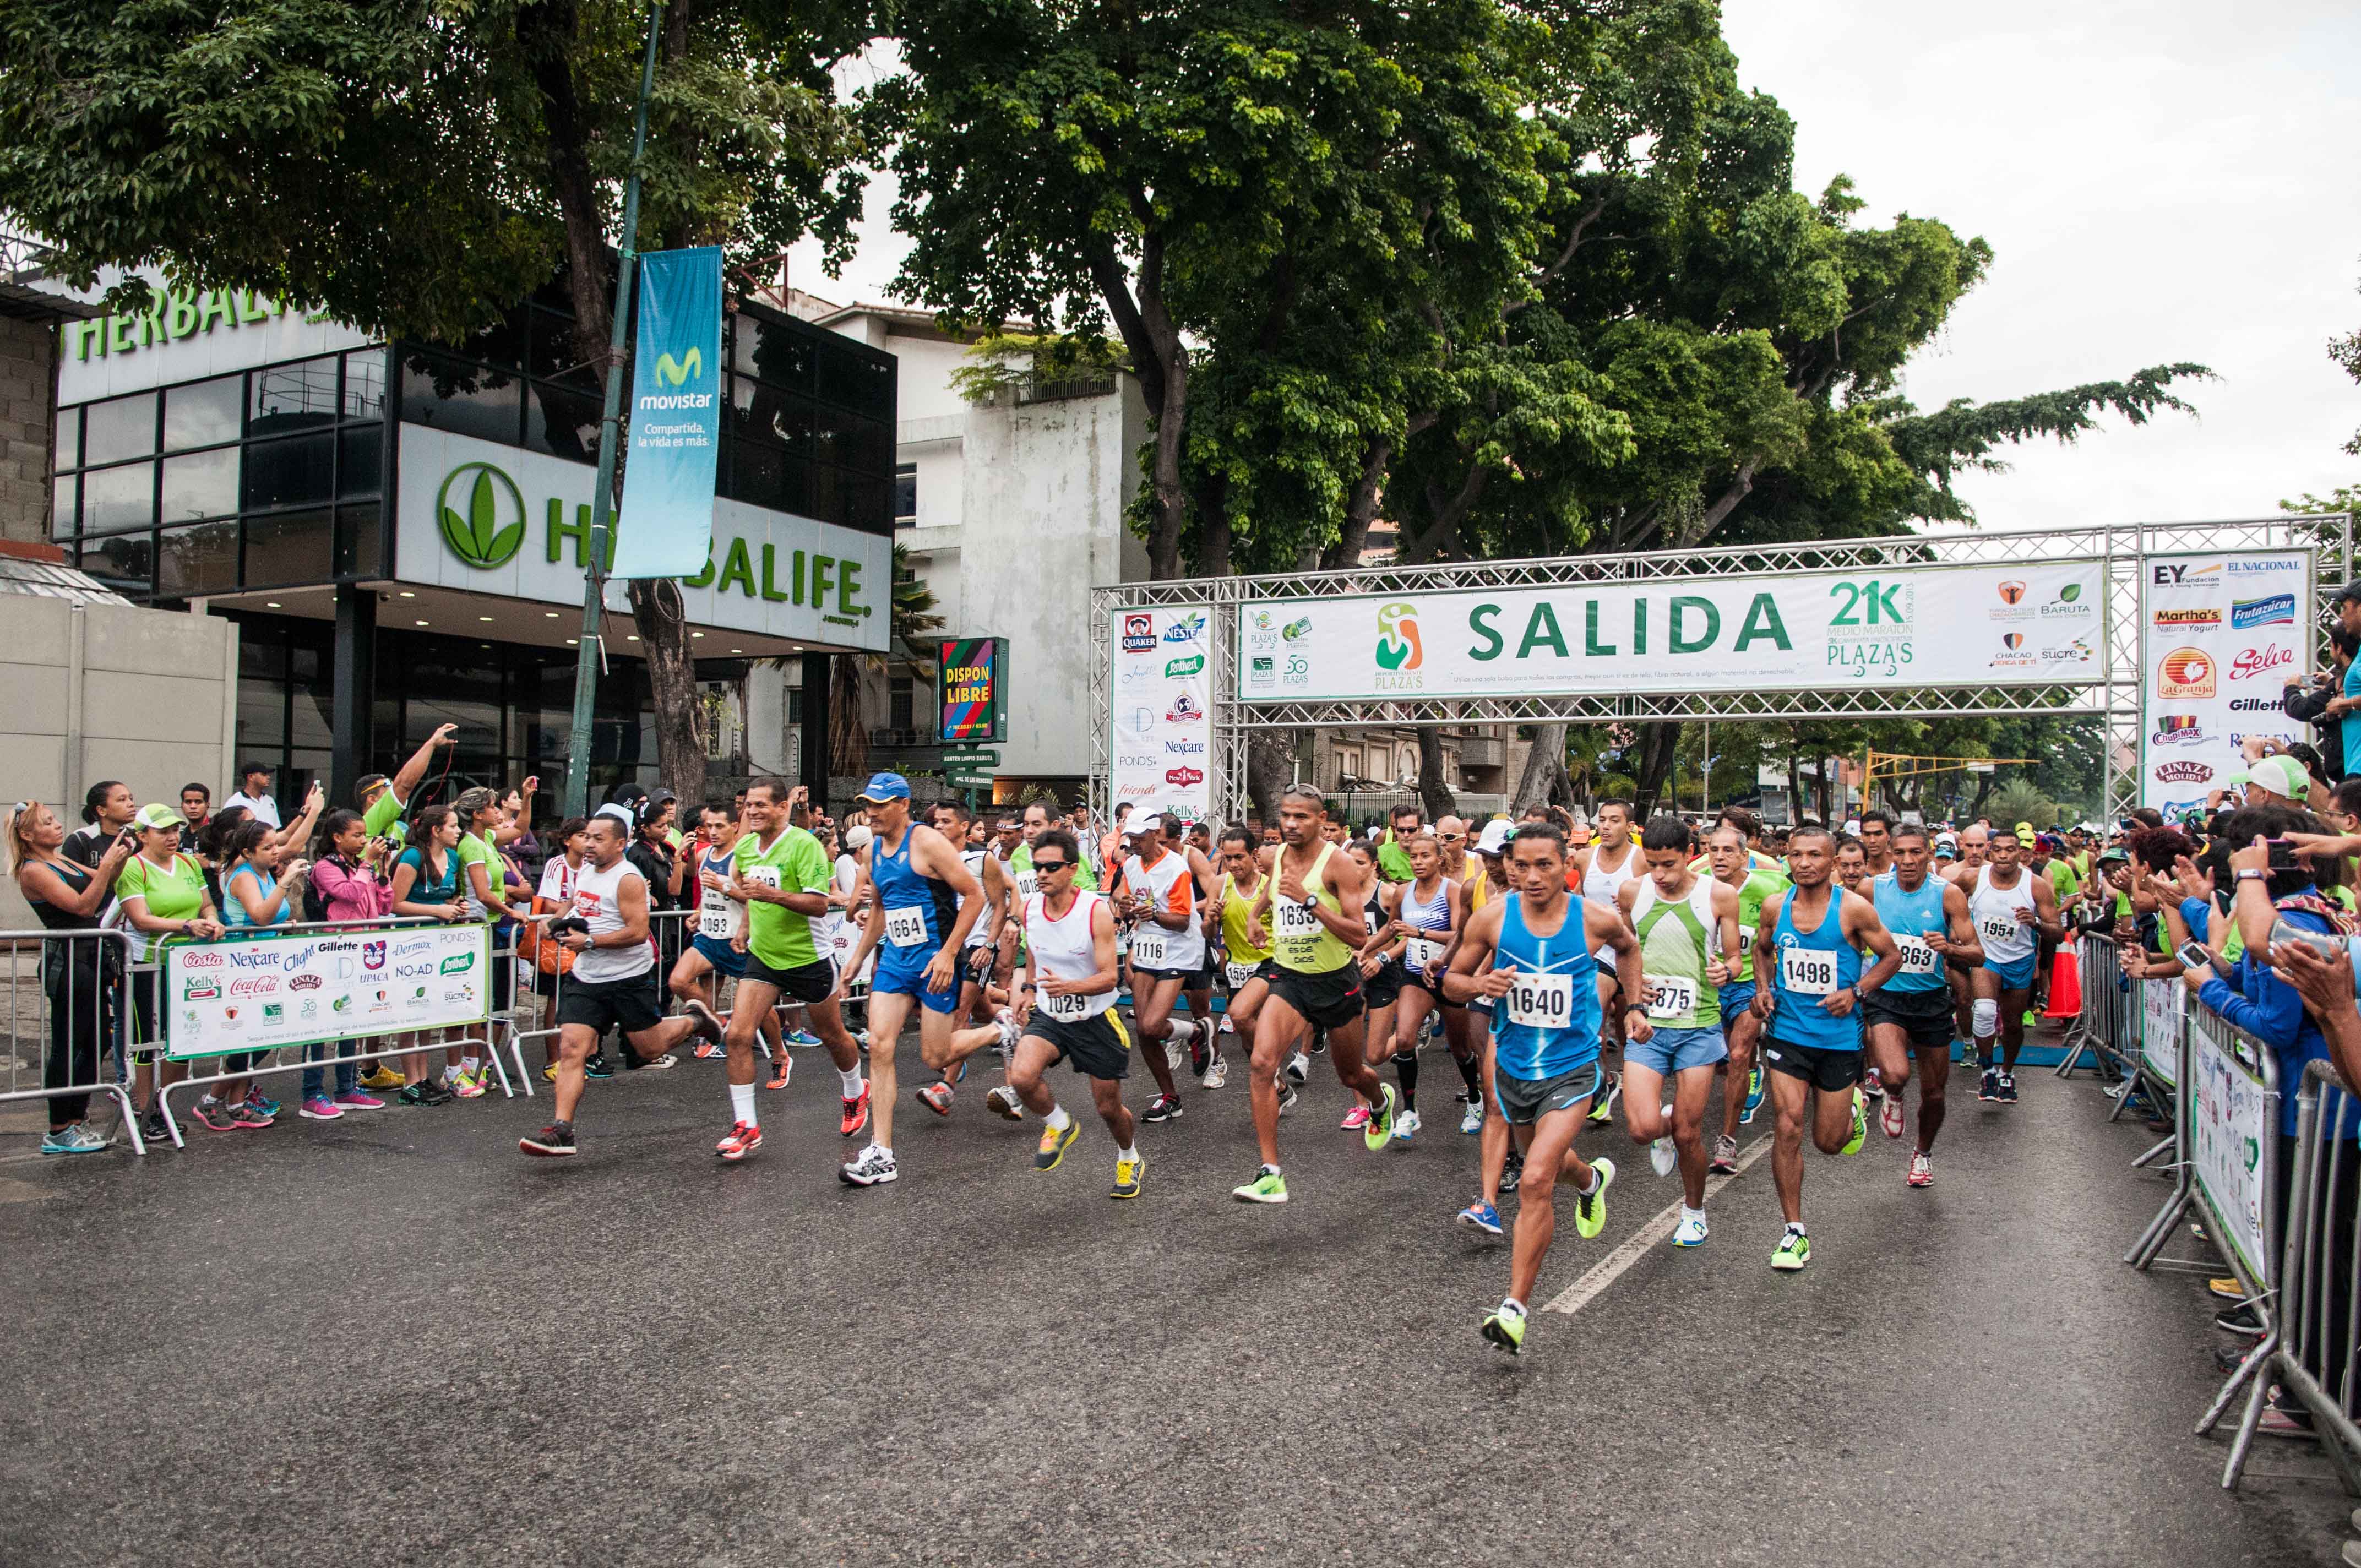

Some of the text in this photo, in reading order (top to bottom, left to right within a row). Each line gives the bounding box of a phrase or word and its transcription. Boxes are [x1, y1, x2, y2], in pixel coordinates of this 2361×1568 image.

[640, 393, 712, 410] movistar
[645, 422, 705, 435] Compartida,
[638, 434, 709, 447] la vida es más.
[2228, 561, 2300, 571] EL NACIONAL
[2154, 564, 2188, 584] EY
[1829, 581, 1905, 625] 21K
[2234, 600, 2292, 620] Frutazúcar
[2157, 609, 2218, 621] Martha's
[1165, 628, 1204, 639] NESTEA
[1468, 592, 1793, 661] SALIDA
[1827, 626, 1860, 637] MEDIO
[2157, 624, 2218, 633] Natural Yogurt
[1123, 638, 1156, 648] QUAKER
[1827, 643, 1913, 665] PLAZA'S
[2042, 650, 2077, 659] sucre
[1283, 655, 1308, 674] 50
[2229, 643, 2294, 680] Selva
[946, 666, 989, 683] DISPON
[1375, 676, 1423, 689] PLAZA'S
[947, 686, 989, 703] LIBRE
[2229, 699, 2285, 711] Gillett
[1165, 741, 1204, 755] Nexcare
[1120, 756, 1154, 766] POND'S
[2157, 761, 2212, 778] LINAZA
[2166, 773, 2202, 782] MOLIDA
[1118, 784, 1157, 798] friends
[1167, 804, 1199, 817] Kelly's
[704, 918, 727, 933] 1093
[889, 917, 921, 938] 1664
[1984, 921, 2015, 937] 1954
[319, 941, 358, 952] Gillette
[1291, 936, 1323, 945] GLORIA
[1136, 941, 1163, 959] 1116
[1421, 945, 1428, 960] 5
[183, 951, 224, 968] Costa
[230, 951, 280, 969] Nexcare
[284, 944, 316, 971] Clight
[1294, 956, 1315, 964] DIOS
[396, 964, 433, 978] NO-AD
[1787, 960, 1830, 984] 1498
[186, 974, 221, 988] Kelly's
[289, 974, 322, 988] LINAZA
[360, 973, 388, 984] UPACA
[444, 991, 466, 1000] sucre
[1510, 987, 1564, 1016] 1640
[1049, 995, 1086, 1014] 1029
